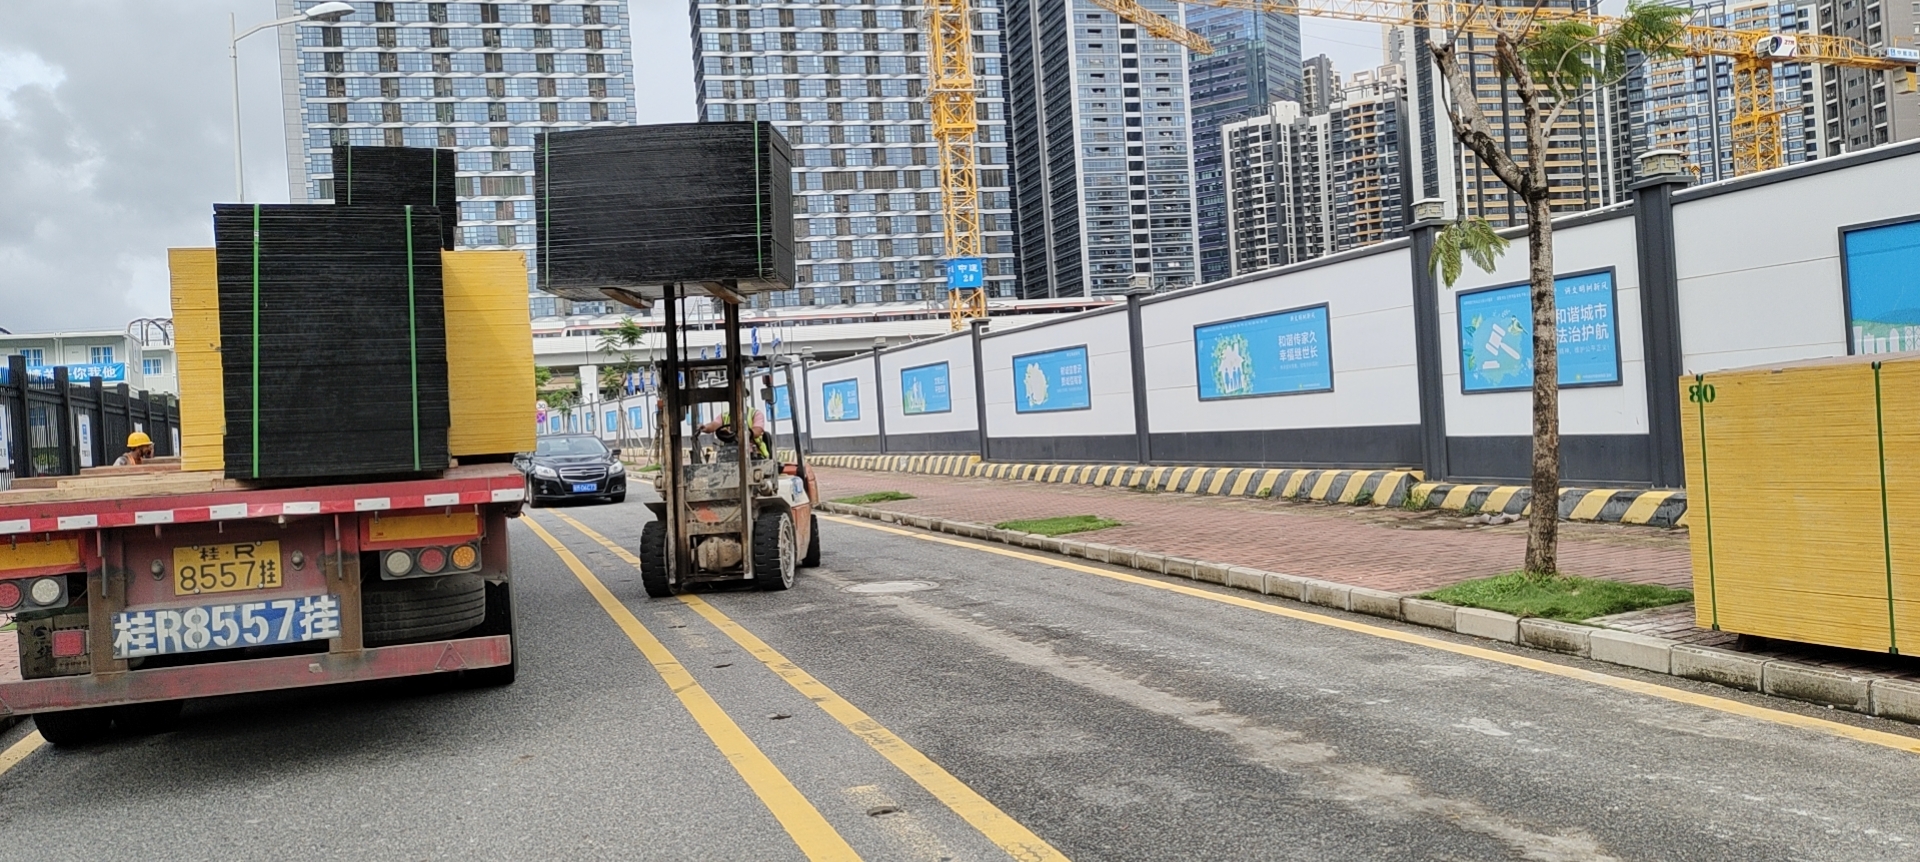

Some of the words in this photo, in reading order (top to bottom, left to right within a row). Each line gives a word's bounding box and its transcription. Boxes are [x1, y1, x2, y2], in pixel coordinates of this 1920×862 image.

[1564, 281, 1609, 295] 讲文明树新风
[1556, 302, 1608, 325] 和谐城市
[1278, 331, 1318, 348] 和谐传家久
[1556, 322, 1609, 344] 法治护航
[1689, 384, 1716, 403] 80
[180, 559, 277, 591] 8557挂
[113, 595, 340, 657] 桂R8557挂
